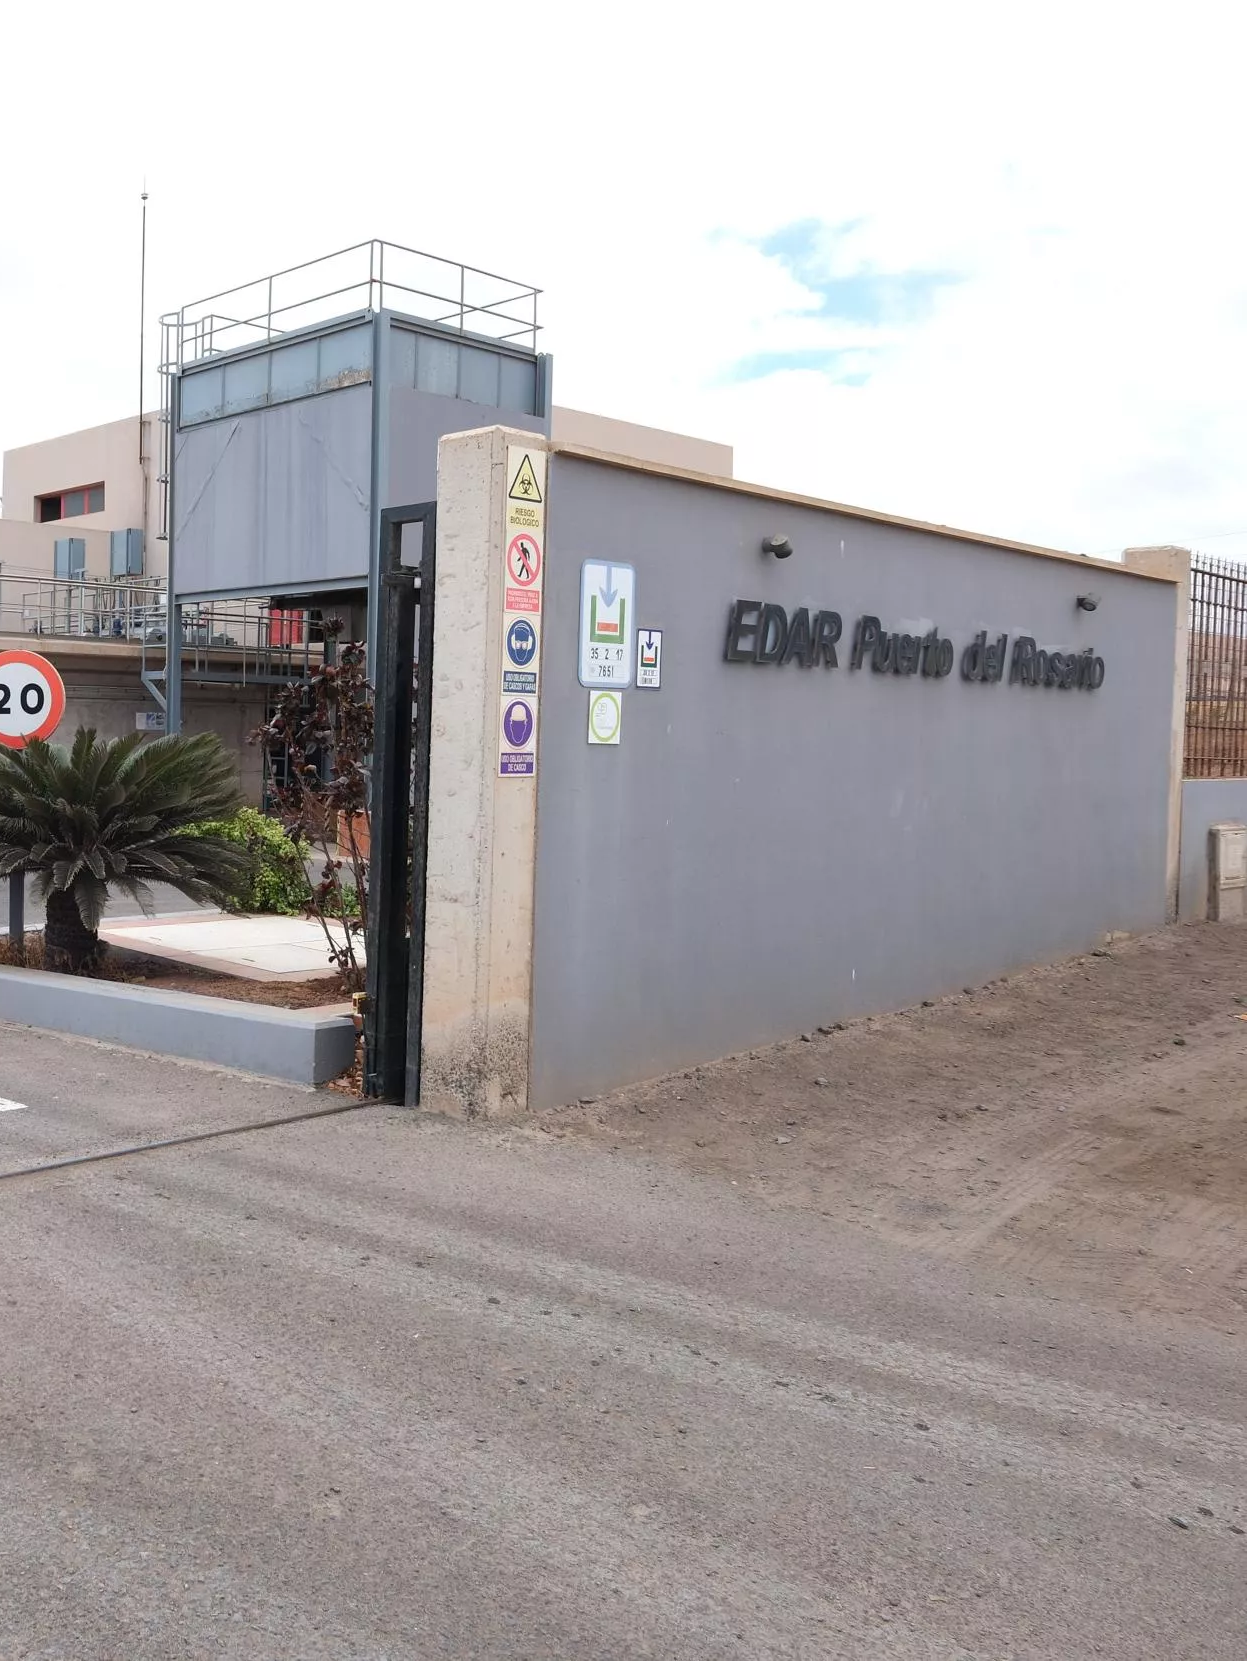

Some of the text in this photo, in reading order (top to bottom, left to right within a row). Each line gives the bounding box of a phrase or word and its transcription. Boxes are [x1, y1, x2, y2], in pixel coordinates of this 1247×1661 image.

[515, 507, 535, 518] RIESGO
[727, 599, 1106, 690] EDAR Puerto del Rosario
[591, 648, 623, 661] 35 2 17
[598, 666, 614, 678] 7651
